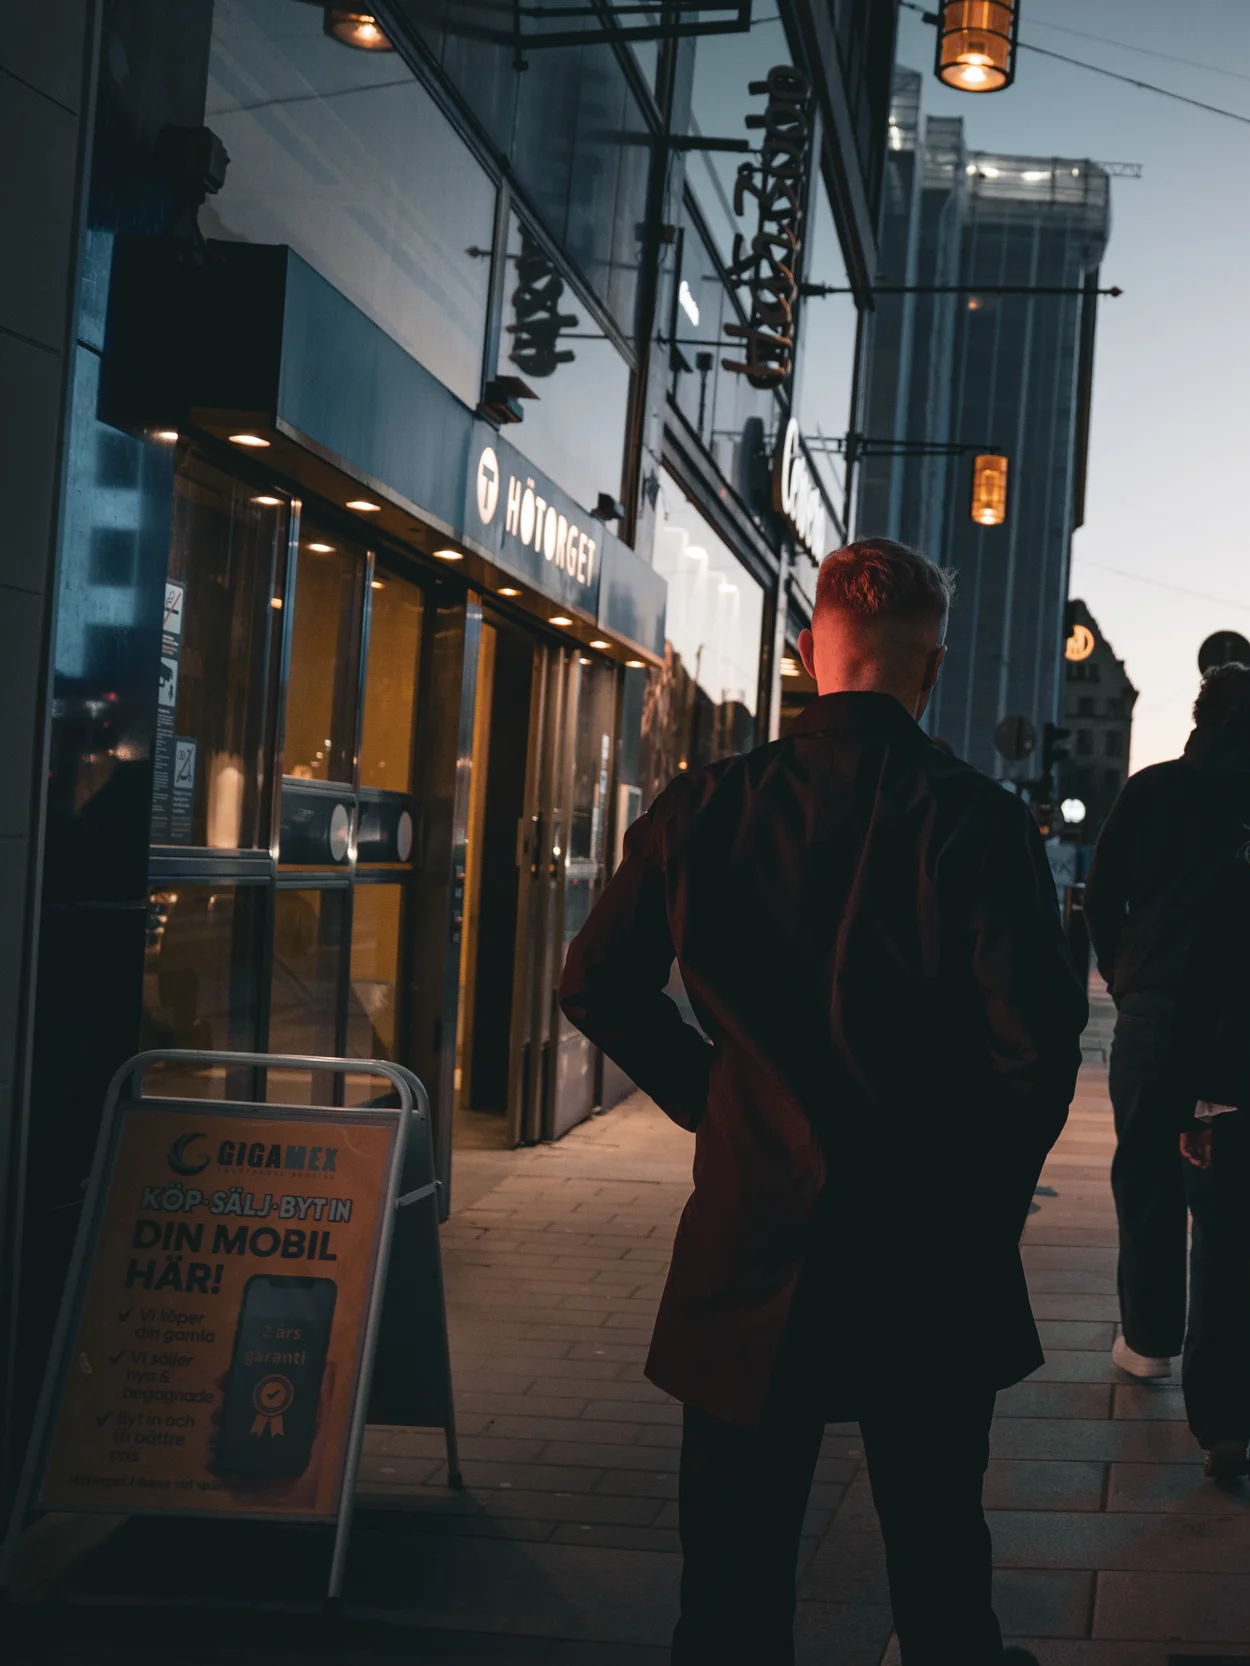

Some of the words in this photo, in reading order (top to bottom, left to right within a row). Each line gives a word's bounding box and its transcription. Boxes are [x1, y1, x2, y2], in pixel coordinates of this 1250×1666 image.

[506, 475, 597, 588] HÖTORGET
[217, 1140, 339, 1173] GIGAMEX
[132, 1219, 204, 1253] DIN
[211, 1224, 338, 1261] MOBIL
[124, 1254, 224, 1294] HÄR!
[140, 1307, 157, 1322] Vi
[160, 1308, 206, 1326] köper
[135, 1325, 160, 1340] din
[163, 1328, 216, 1344] gamla
[262, 1324, 271, 1339] 2
[275, 1323, 302, 1340] års
[149, 1351, 195, 1369] säljer
[243, 1350, 306, 1366] garanti
[126, 1370, 156, 1385] nya
[159, 1370, 171, 1384] &
[122, 1386, 215, 1405] begagnade
[116, 1410, 144, 1429] Byt
[146, 1411, 163, 1426] in
[165, 1414, 196, 1429] och
[133, 1429, 187, 1447] bättre
